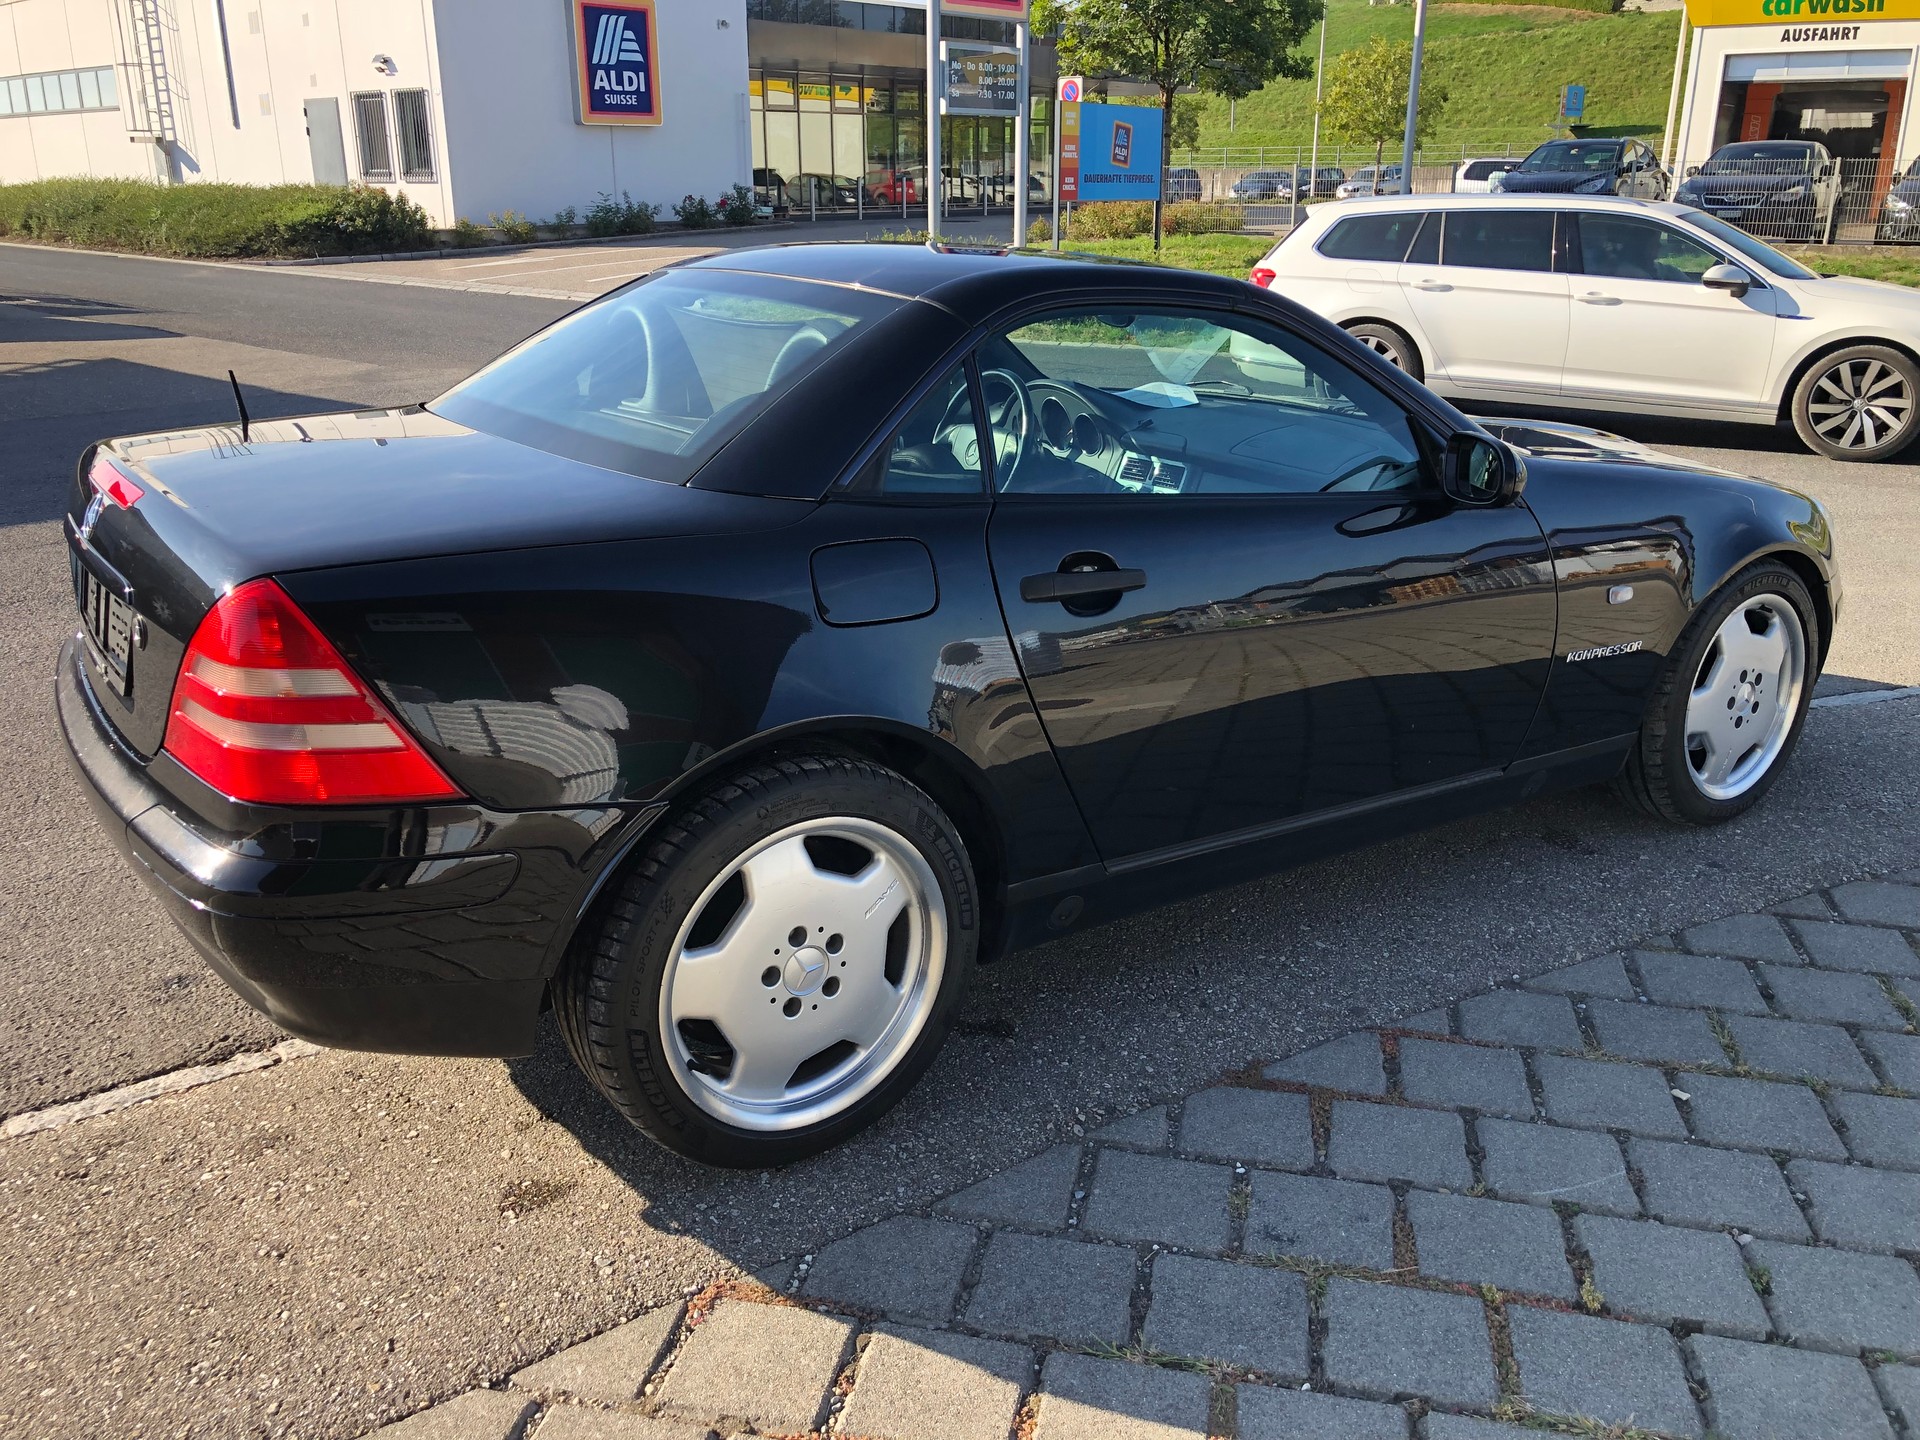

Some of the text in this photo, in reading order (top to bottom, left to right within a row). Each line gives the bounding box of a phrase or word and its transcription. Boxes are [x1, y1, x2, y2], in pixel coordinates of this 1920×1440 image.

[1780, 26, 1860, 42] AUSFAHRT
[951, 61, 961, 70] Mo
[967, 62, 975, 71] Do
[978, 62, 992, 71] 8.00
[998, 64, 1014, 73] 19.00
[594, 69, 645, 92] ALDI
[951, 75, 958, 83] Fr
[978, 76, 993, 85] 8.00
[998, 77, 1014, 86] 20.00
[604, 94, 637, 105] SUISSE
[951, 89, 960, 97] Sa
[978, 90, 992, 99] 7.30
[998, 91, 1014, 100] 17.00
[1114, 146, 1128, 156] ALDI
[1084, 173, 1122, 183] DAUERHAFTE
[1744, 575, 1788, 595] MICHELIN
[1566, 640, 1643, 663] KOMPRESSOR
[935, 836, 973, 927] MICHELIN
[629, 978, 641, 1017] PILOT
[637, 926, 657, 975] SPORT
[630, 1035, 687, 1127] MICHELIN
